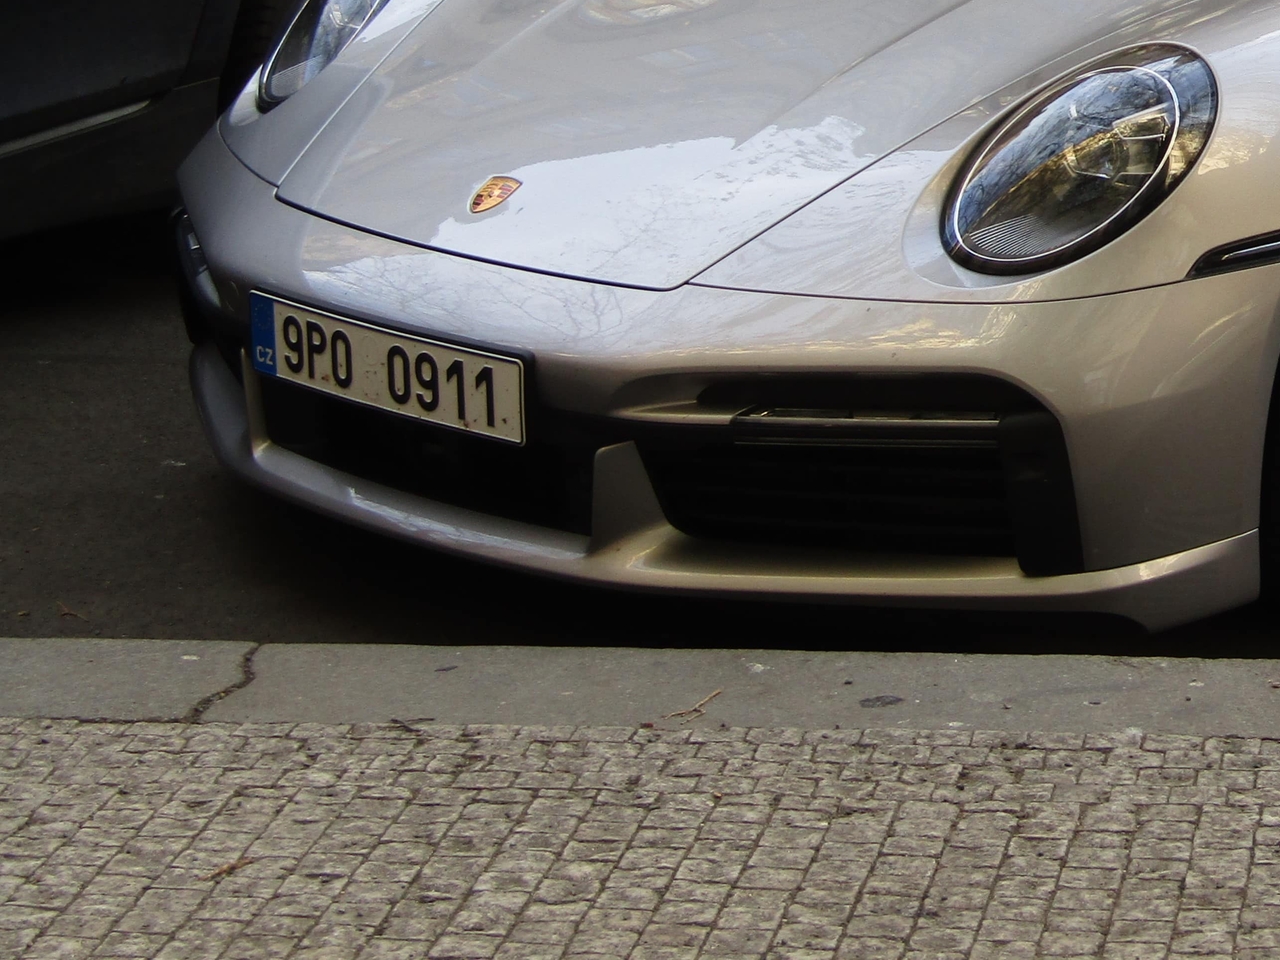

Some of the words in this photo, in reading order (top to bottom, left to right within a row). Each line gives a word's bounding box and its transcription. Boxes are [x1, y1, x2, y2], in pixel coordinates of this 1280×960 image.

[255, 344, 275, 366] CZ
[282, 313, 354, 389] 9P0
[386, 344, 496, 428] 0911
